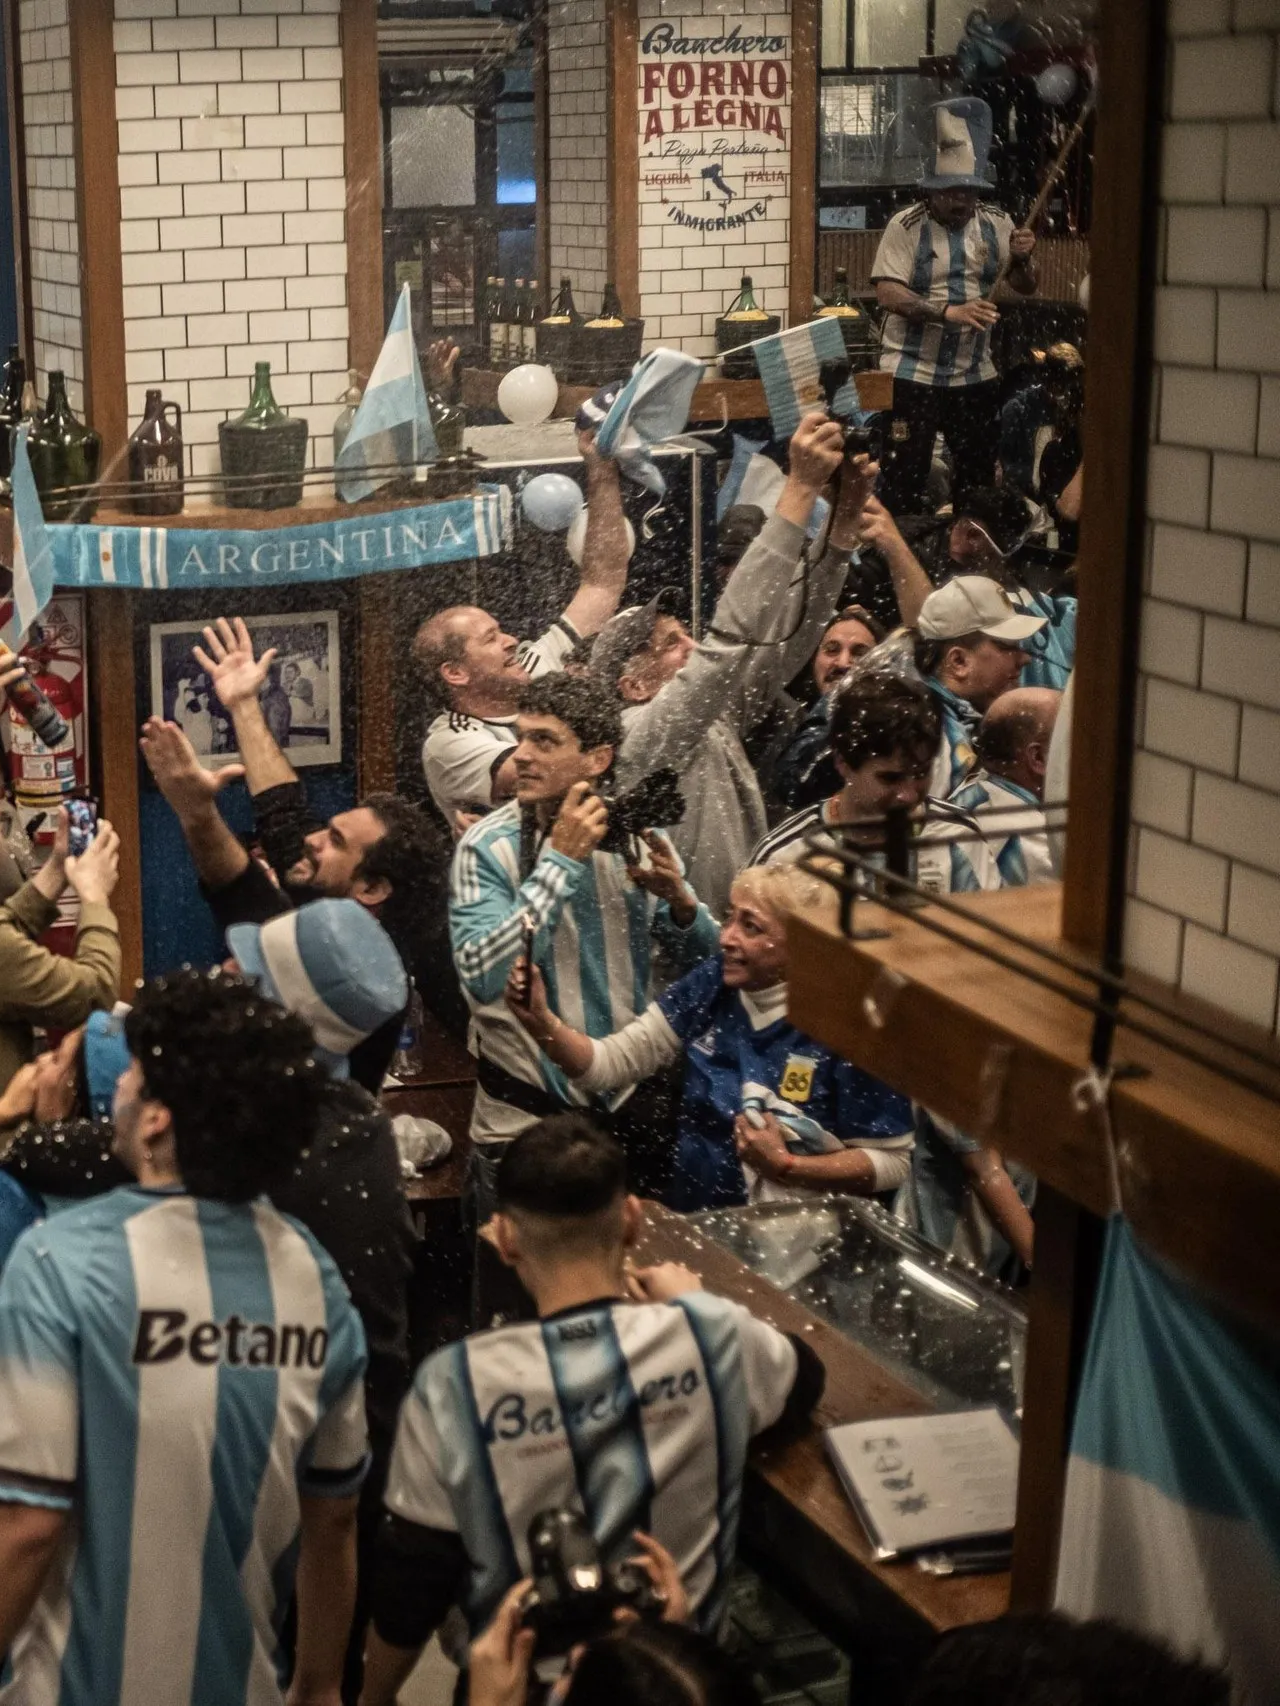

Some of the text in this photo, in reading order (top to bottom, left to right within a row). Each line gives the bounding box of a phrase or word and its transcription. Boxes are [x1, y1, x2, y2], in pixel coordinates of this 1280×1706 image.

[642, 23, 786, 55] Banchero
[643, 60, 787, 104] FORNO
[645, 173, 691, 186] LIGURIA
[744, 170, 785, 183] ITALIA
[667, 202, 766, 231] INMIGRANTE
[180, 516, 466, 576] ARGENTINA
[133, 1308, 329, 1369] Betano
